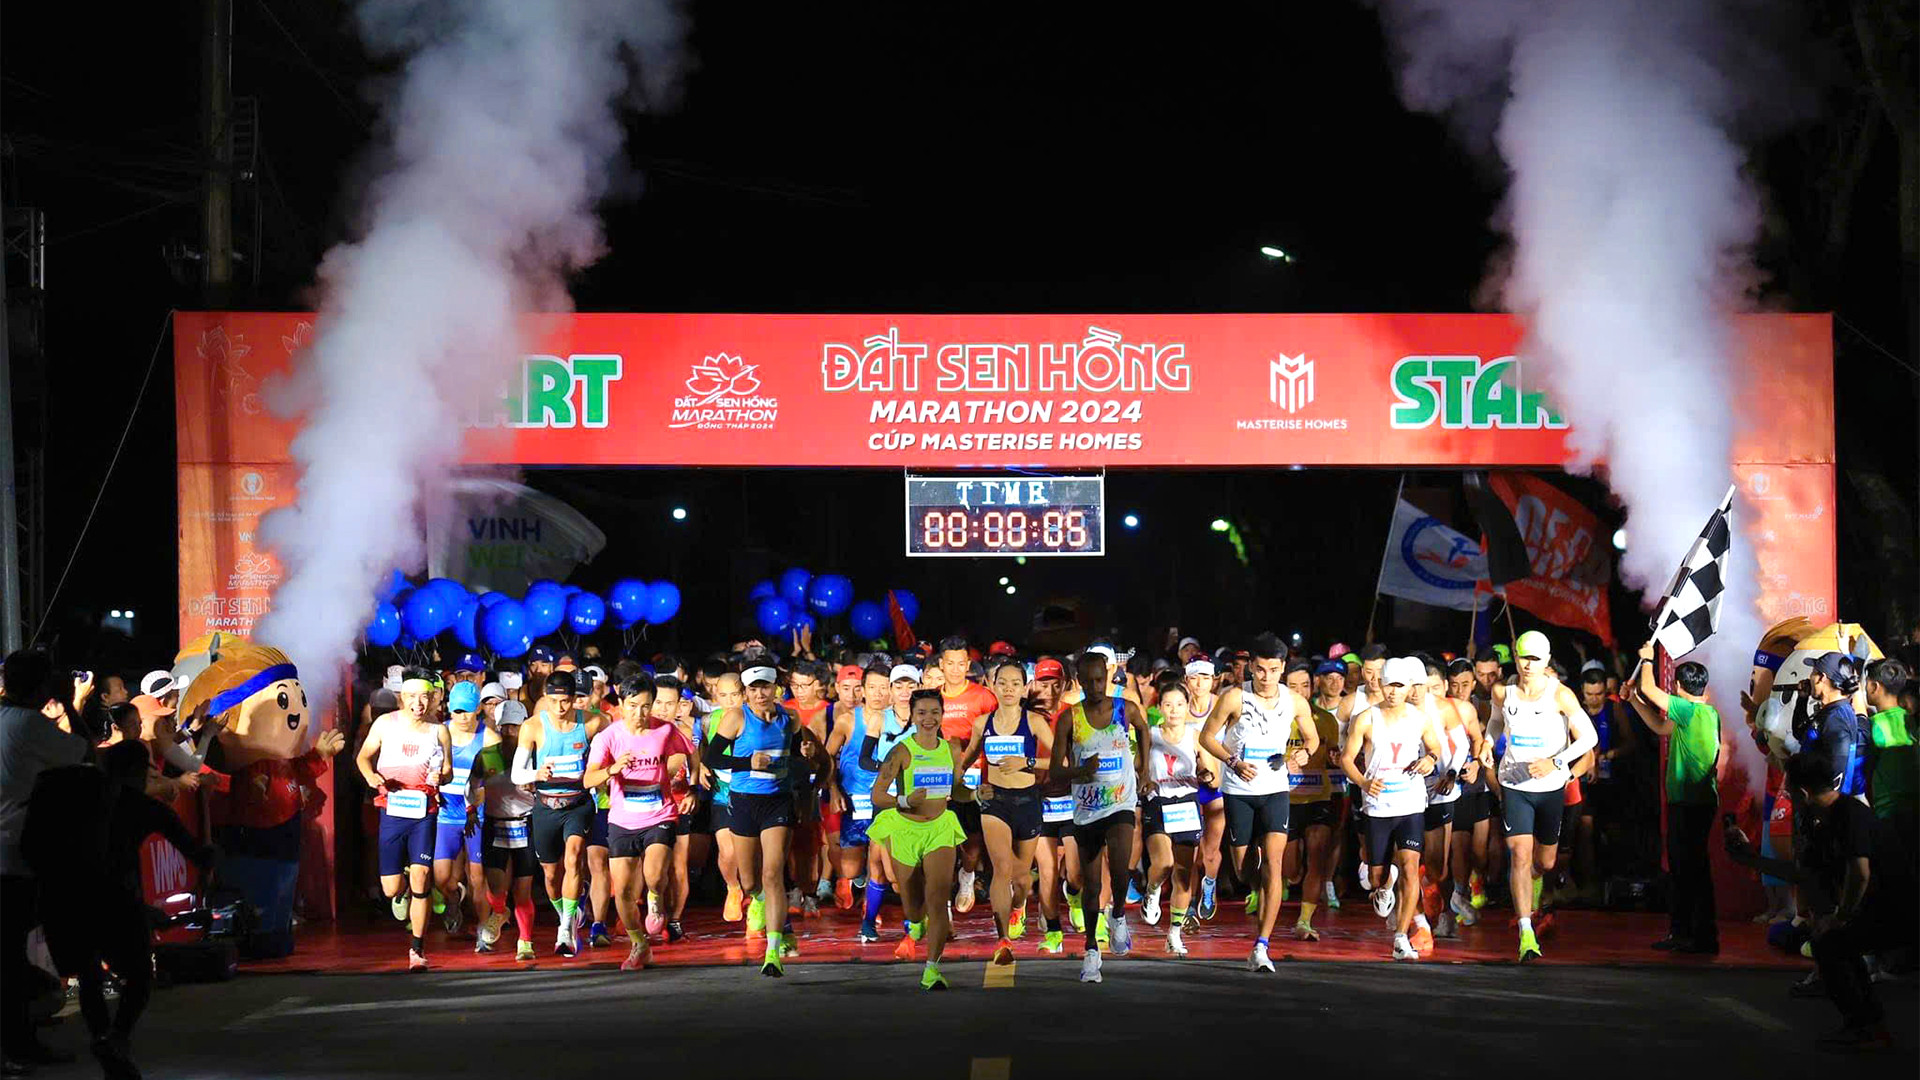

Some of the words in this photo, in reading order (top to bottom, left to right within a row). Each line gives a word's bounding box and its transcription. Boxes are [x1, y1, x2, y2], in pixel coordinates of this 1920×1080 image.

[821, 327, 928, 392] ĐẤT
[936, 344, 1030, 392] SEN
[1039, 326, 1191, 392] HỒNG
[716, 398, 740, 408] SEN
[1390, 355, 1568, 430] STA
[672, 409, 778, 421] MARATHON
[869, 400, 1053, 424] MARATHON
[1059, 400, 1143, 424] 2024
[1236, 419, 1302, 430] MASTERISE
[1304, 419, 1348, 430] HOMES
[868, 430, 915, 450] CÚP
[921, 433, 1053, 450] MASTERISE
[1059, 433, 1143, 450] HOMES
[956, 481, 1050, 505] TIME
[468, 517, 541, 541] VINH
[924, 511, 1087, 548] 00:00:05
[205, 617, 255, 627] MARATH
